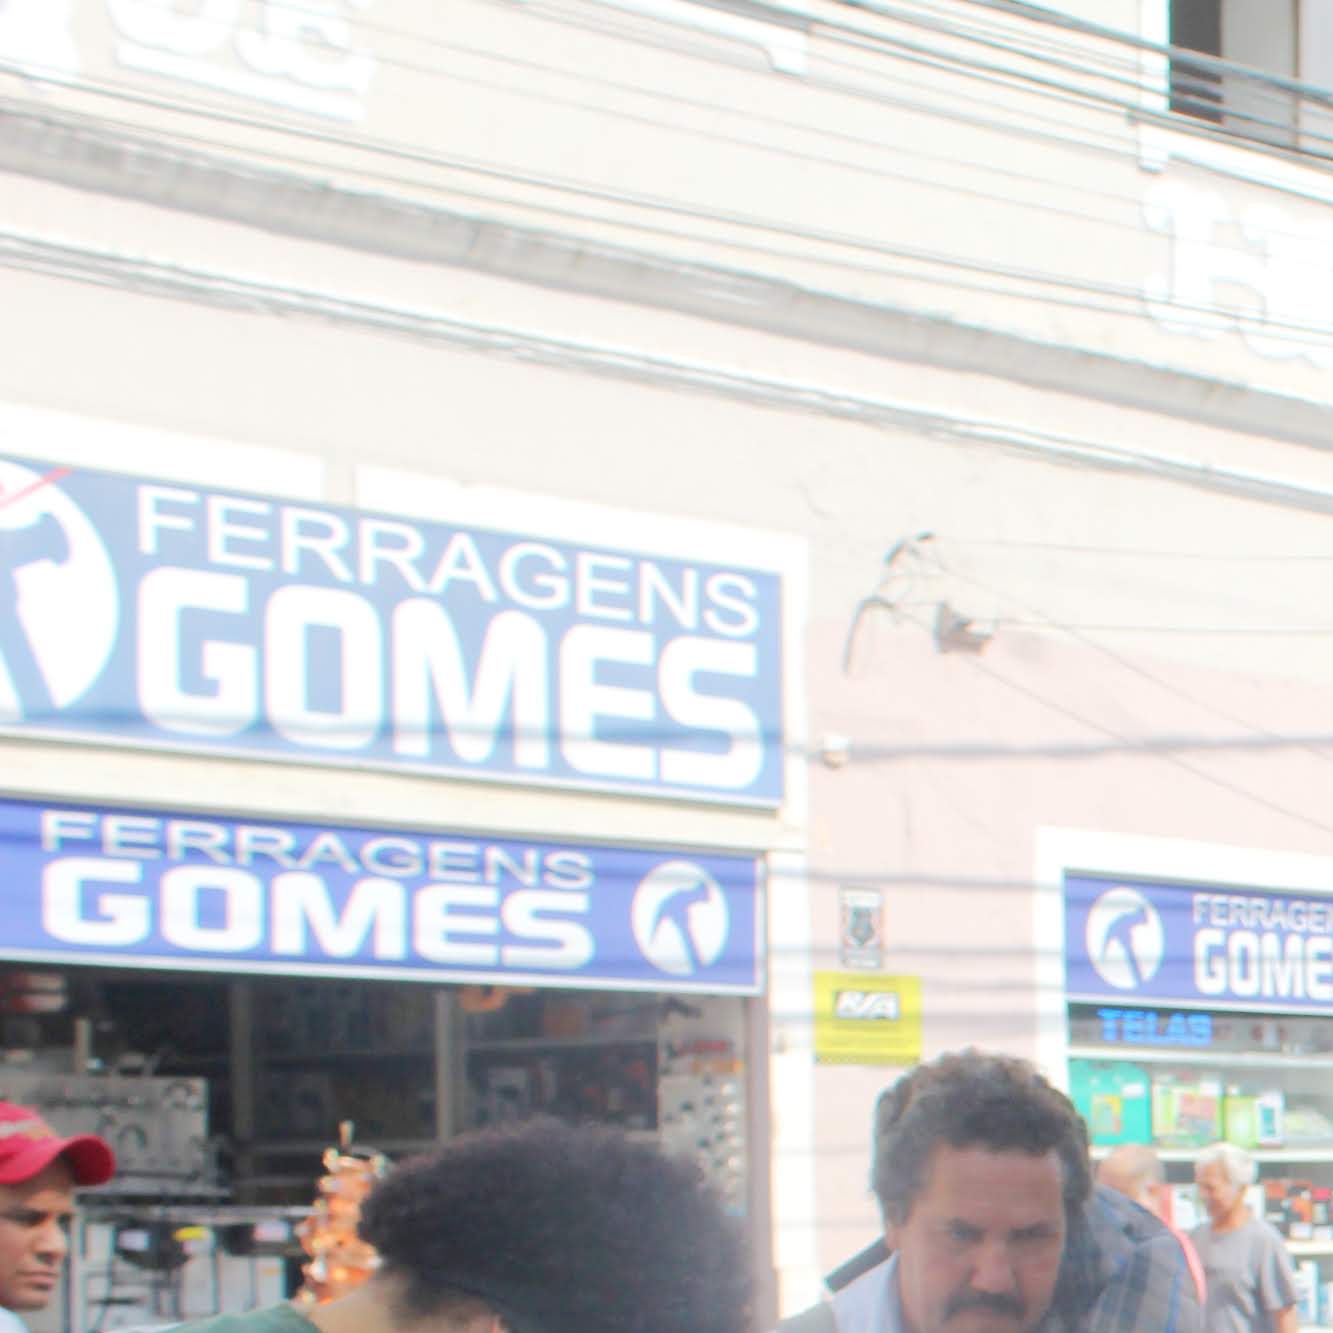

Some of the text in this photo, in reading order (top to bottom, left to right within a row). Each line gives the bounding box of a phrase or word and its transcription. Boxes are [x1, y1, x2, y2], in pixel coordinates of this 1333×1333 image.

[135, 484, 760, 638] FERRAGENS
[135, 565, 766, 790] GOMES
[40, 809, 594, 890] FERRAGENS
[41, 855, 597, 970] GOMES
